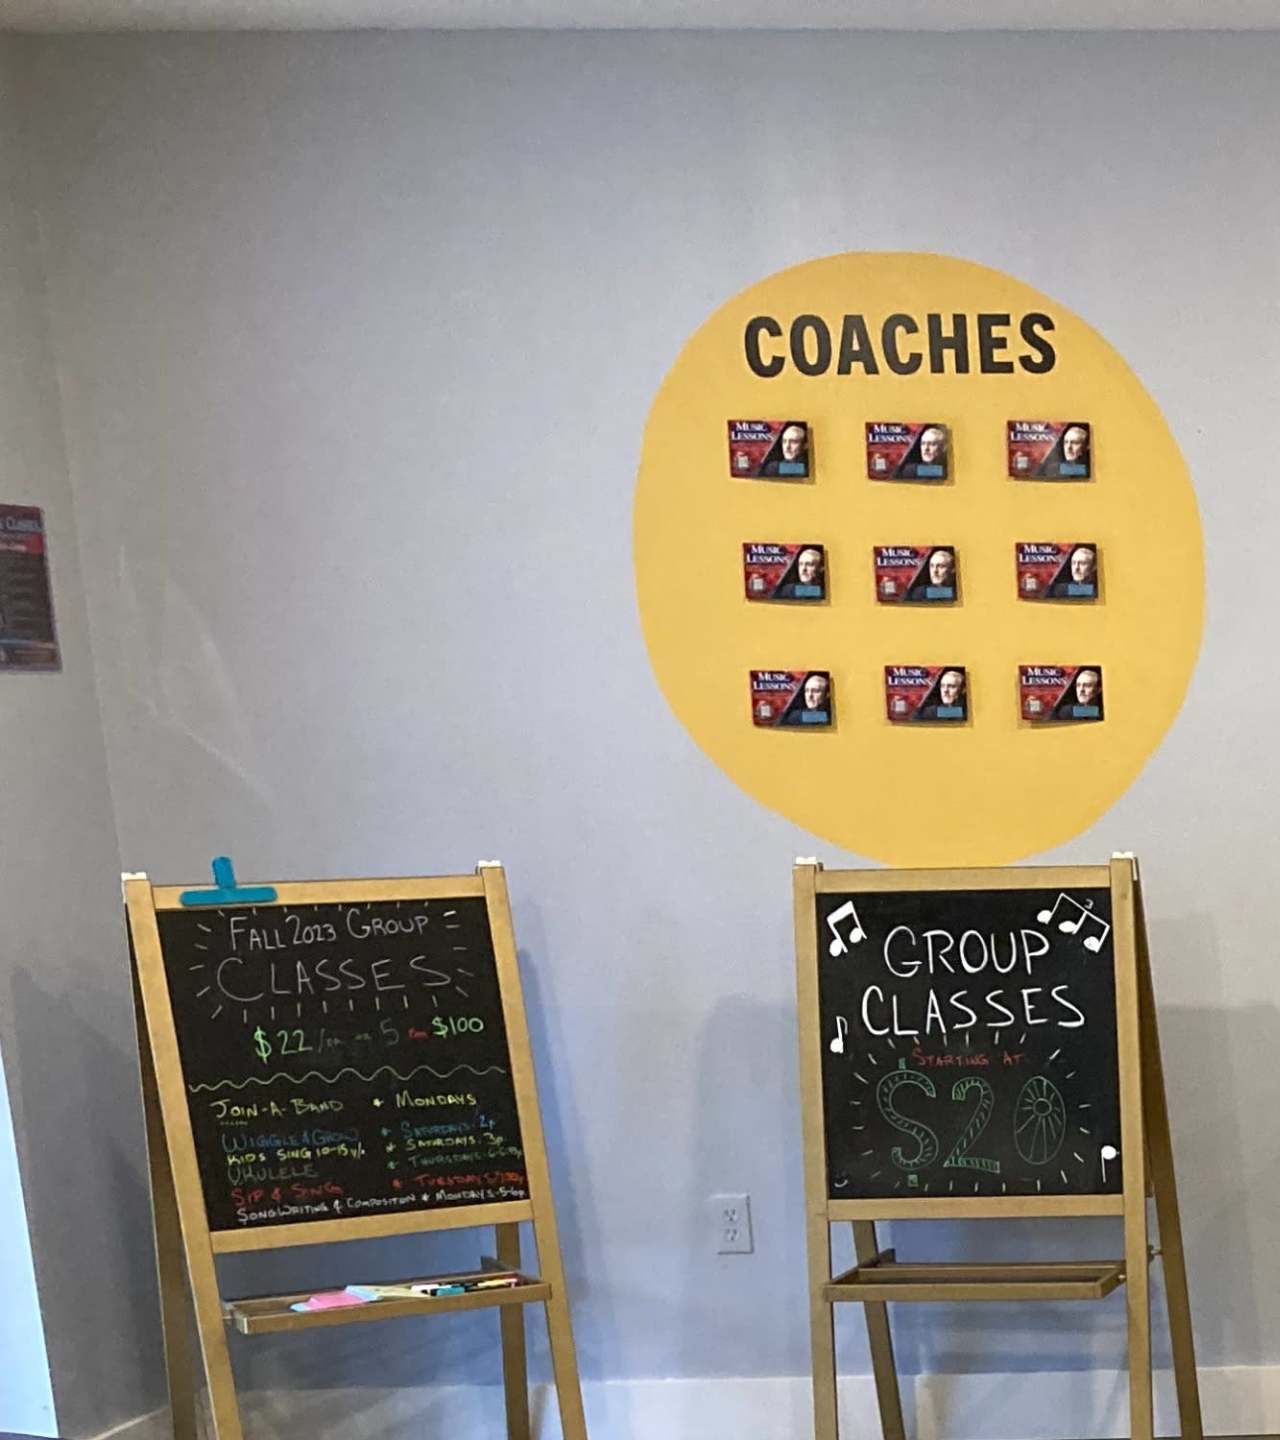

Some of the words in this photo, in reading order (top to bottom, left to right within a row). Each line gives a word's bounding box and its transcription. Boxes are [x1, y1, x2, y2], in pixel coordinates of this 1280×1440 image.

[745, 312, 1056, 378] COACHES
[230, 916, 287, 951] FALL
[285, 915, 336, 945] 2023
[346, 908, 429, 940] GROUP
[884, 925, 1050, 977] GROUP
[217, 955, 451, 1002] CLASSES
[431, 1016, 485, 1039] $100
[862, 985, 1085, 1035] CLASSES
[913, 1050, 989, 1066] STARTING
[1003, 1053, 1025, 1064] AT
[396, 1090, 477, 1108] MONDAYS
[227, 1153, 266, 1166] KIDS
[276, 1148, 312, 1162] SING
